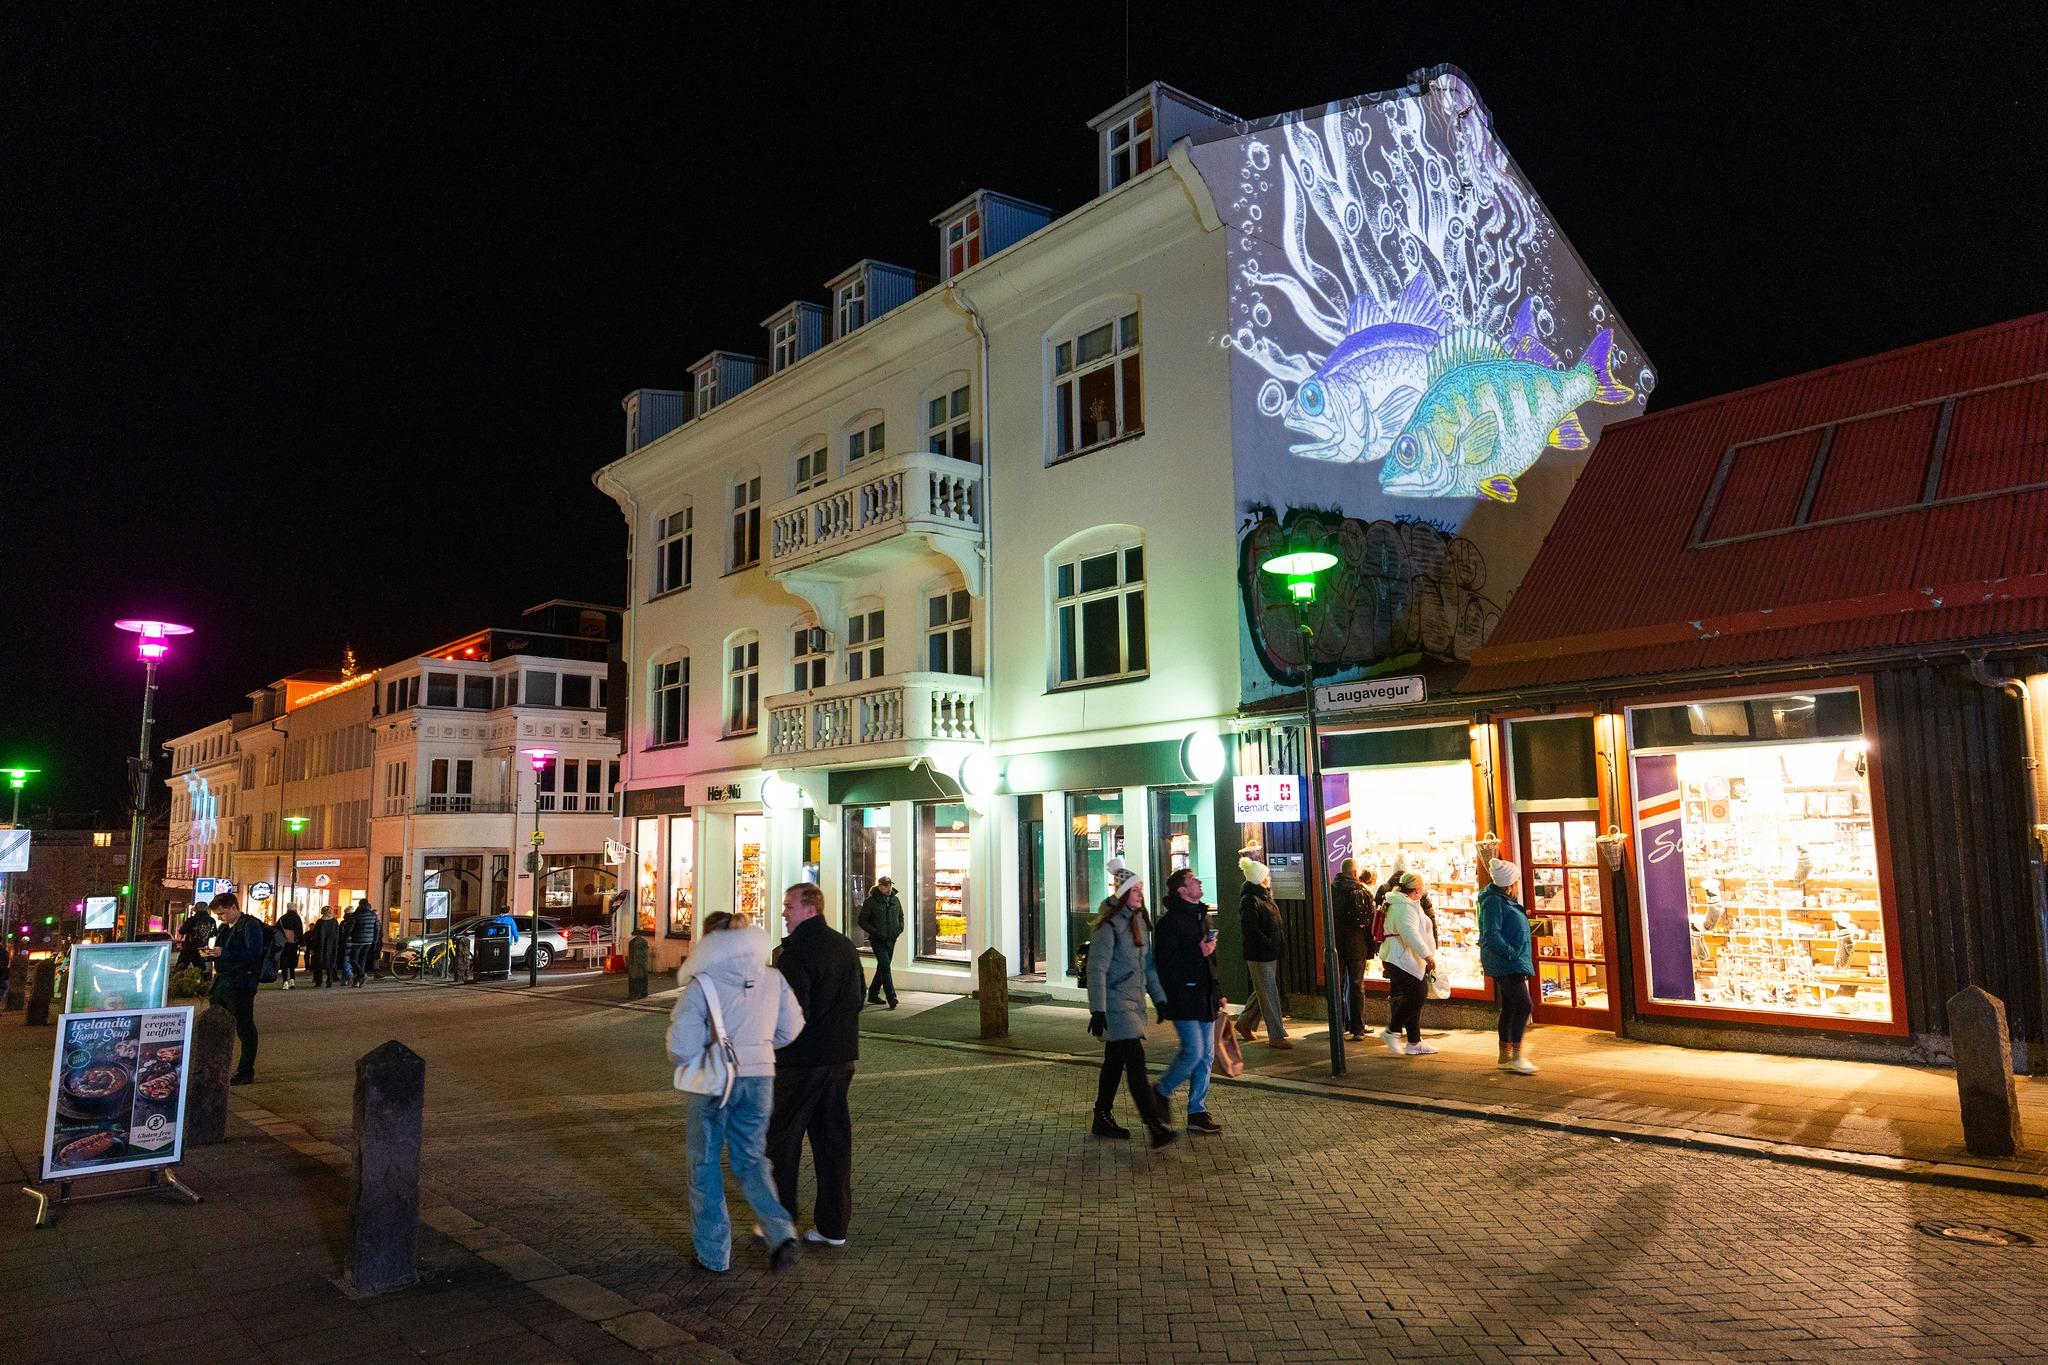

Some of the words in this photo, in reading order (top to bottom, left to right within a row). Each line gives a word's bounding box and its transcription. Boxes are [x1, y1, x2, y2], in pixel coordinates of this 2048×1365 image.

[1327, 685, 1410, 703] Laugavegur
[1237, 803, 1269, 813] icemart
[1273, 802, 1298, 812] icemart
[201, 881, 211, 891] P
[71, 1018, 131, 1031] Icelandic
[145, 1021, 175, 1029] crepes
[68, 1030, 99, 1045] Lamb
[103, 1028, 130, 1042] Soup
[146, 1028, 181, 1037] waffles
